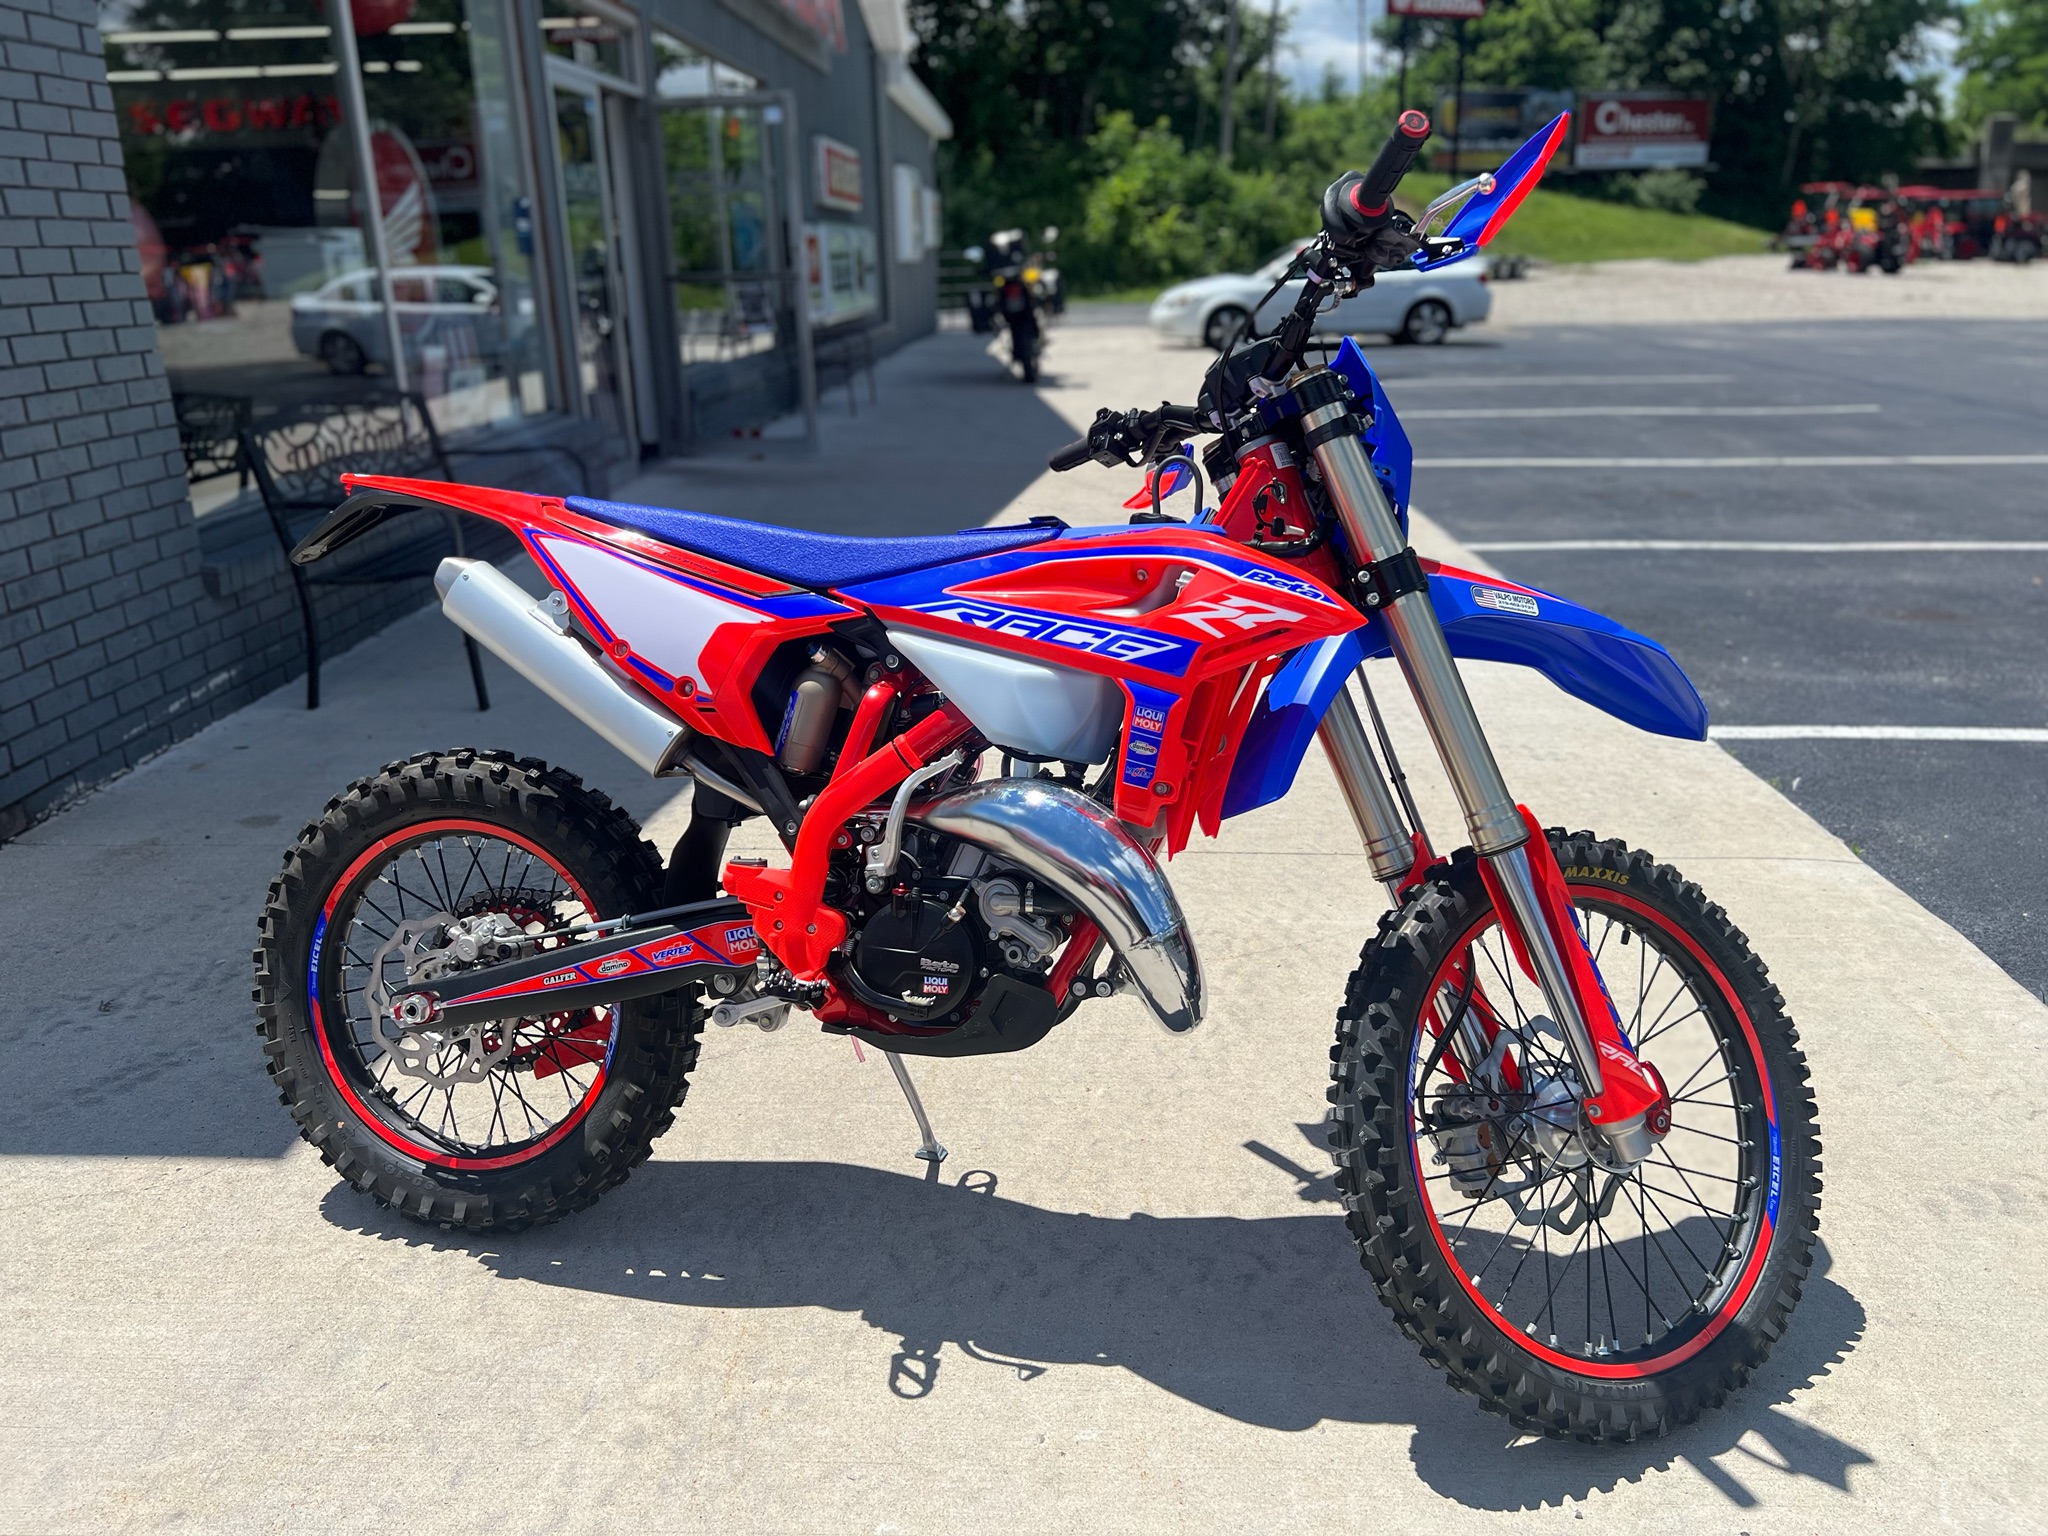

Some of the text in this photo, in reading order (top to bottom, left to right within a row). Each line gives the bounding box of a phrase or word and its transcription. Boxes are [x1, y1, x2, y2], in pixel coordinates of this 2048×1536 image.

[1242, 569, 1324, 600] Beta
[1494, 592, 1535, 605] VALPO MOTORS
[918, 600, 1183, 662] RACE
[1136, 707, 1163, 722] LIQUI
[1134, 717, 1161, 731] MOLY
[1564, 866, 1630, 885] MAXXIS
[728, 927, 755, 942] LIQU
[311, 937, 323, 973] EXCEL
[652, 944, 694, 962] VERTEX
[920, 957, 960, 969] Beta
[543, 972, 577, 986] GALFER
[924, 976, 948, 985] LIQUI
[923, 985, 948, 994] MOLY
[1598, 1040, 1644, 1078] RAC
[1770, 1155, 1780, 1197] EXCEL
